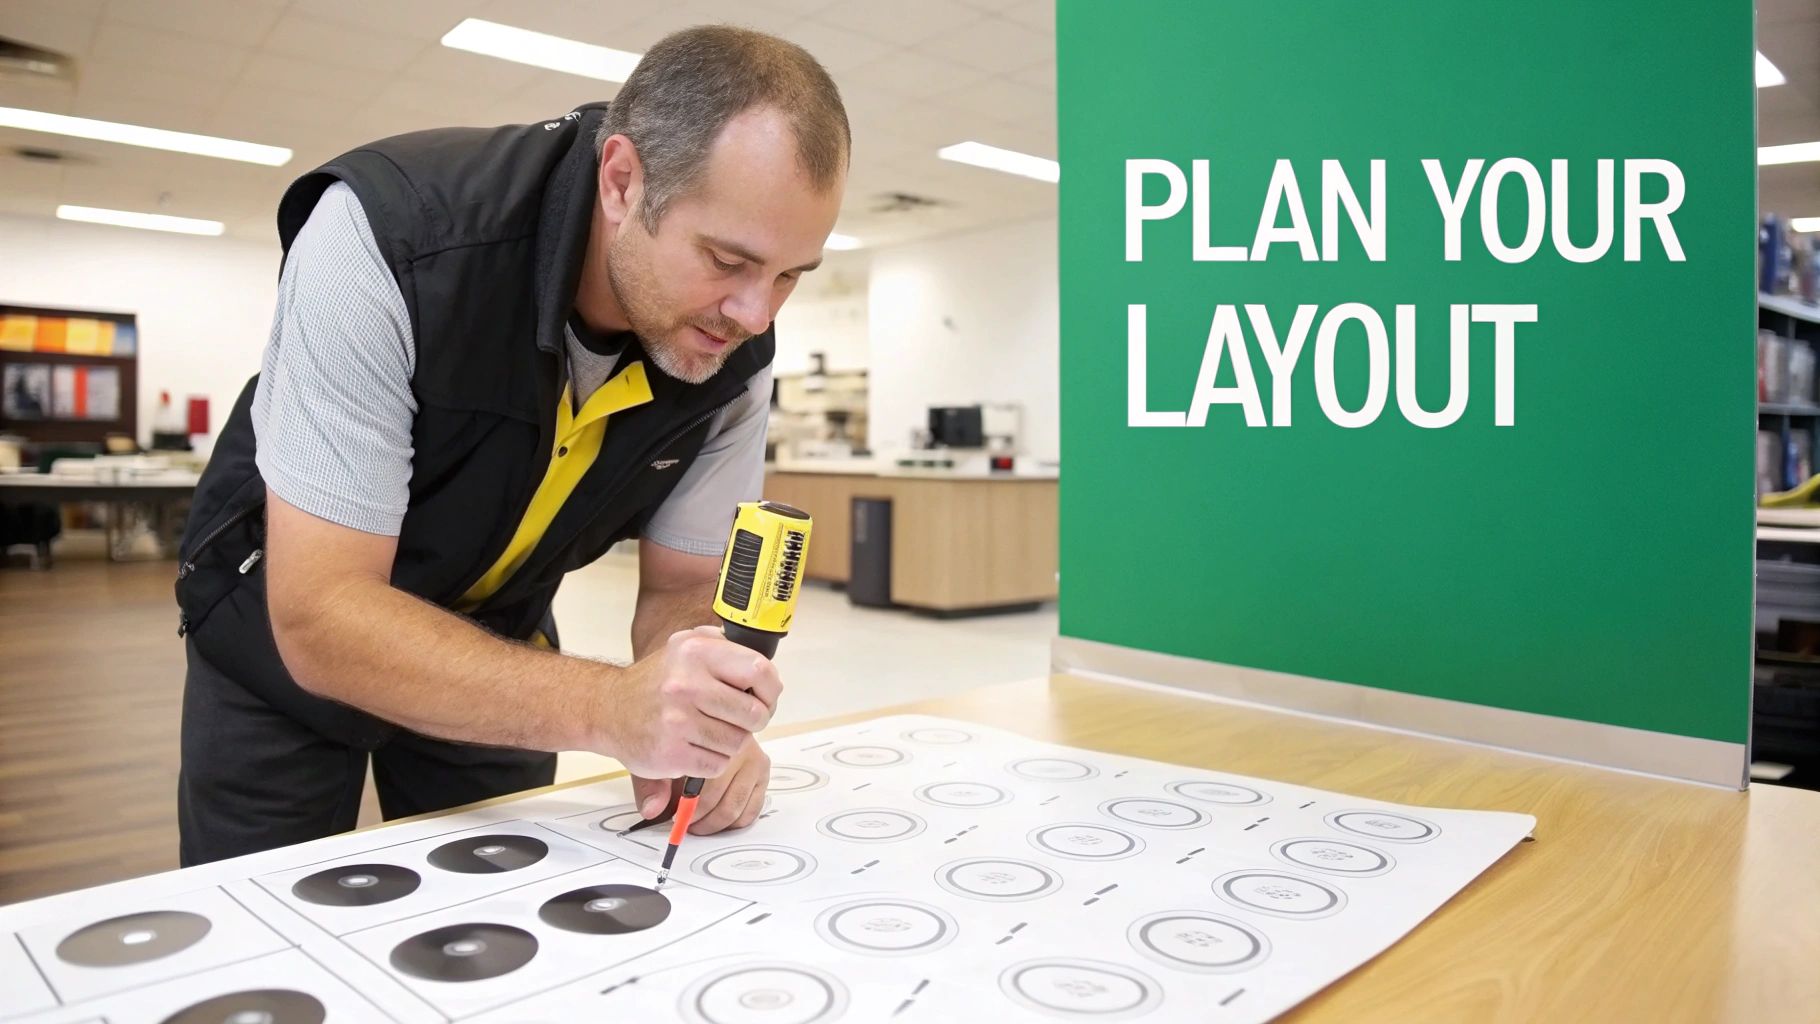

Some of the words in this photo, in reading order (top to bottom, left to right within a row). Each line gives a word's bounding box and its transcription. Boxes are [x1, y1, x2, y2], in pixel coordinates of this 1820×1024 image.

[1125, 158, 1387, 262] PLAN
[1420, 157, 1687, 264] YOUR
[1127, 302, 1539, 429] LAYOUT
